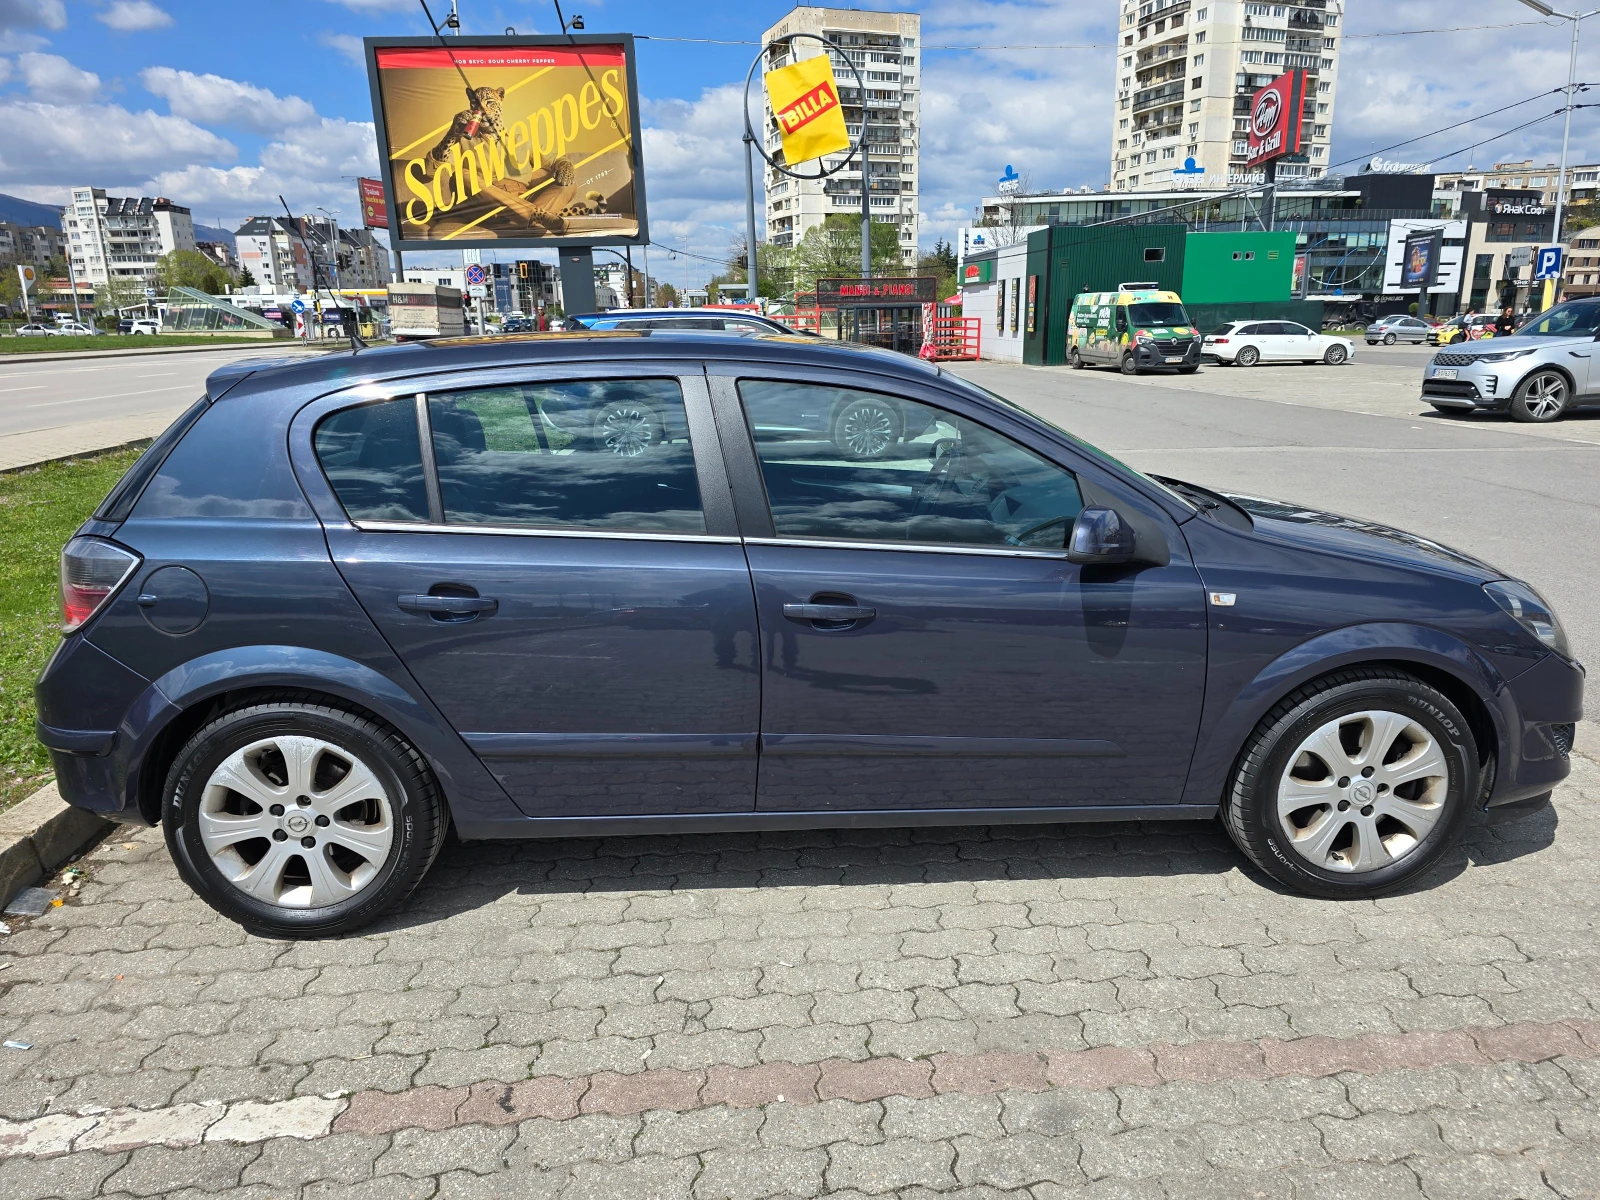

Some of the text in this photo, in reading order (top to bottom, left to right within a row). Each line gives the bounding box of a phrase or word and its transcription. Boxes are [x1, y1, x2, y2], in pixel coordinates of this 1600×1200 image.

[783, 88, 833, 129] BILLA
[404, 68, 624, 226] Schweppes
[1247, 130, 1281, 161] Bar & Grill
[586, 170, 608, 185] ОТ 1783
[1502, 204, 1547, 215] Янак Софт
[1542, 252, 1556, 275] P
[1408, 695, 1461, 736] DUNLOP
